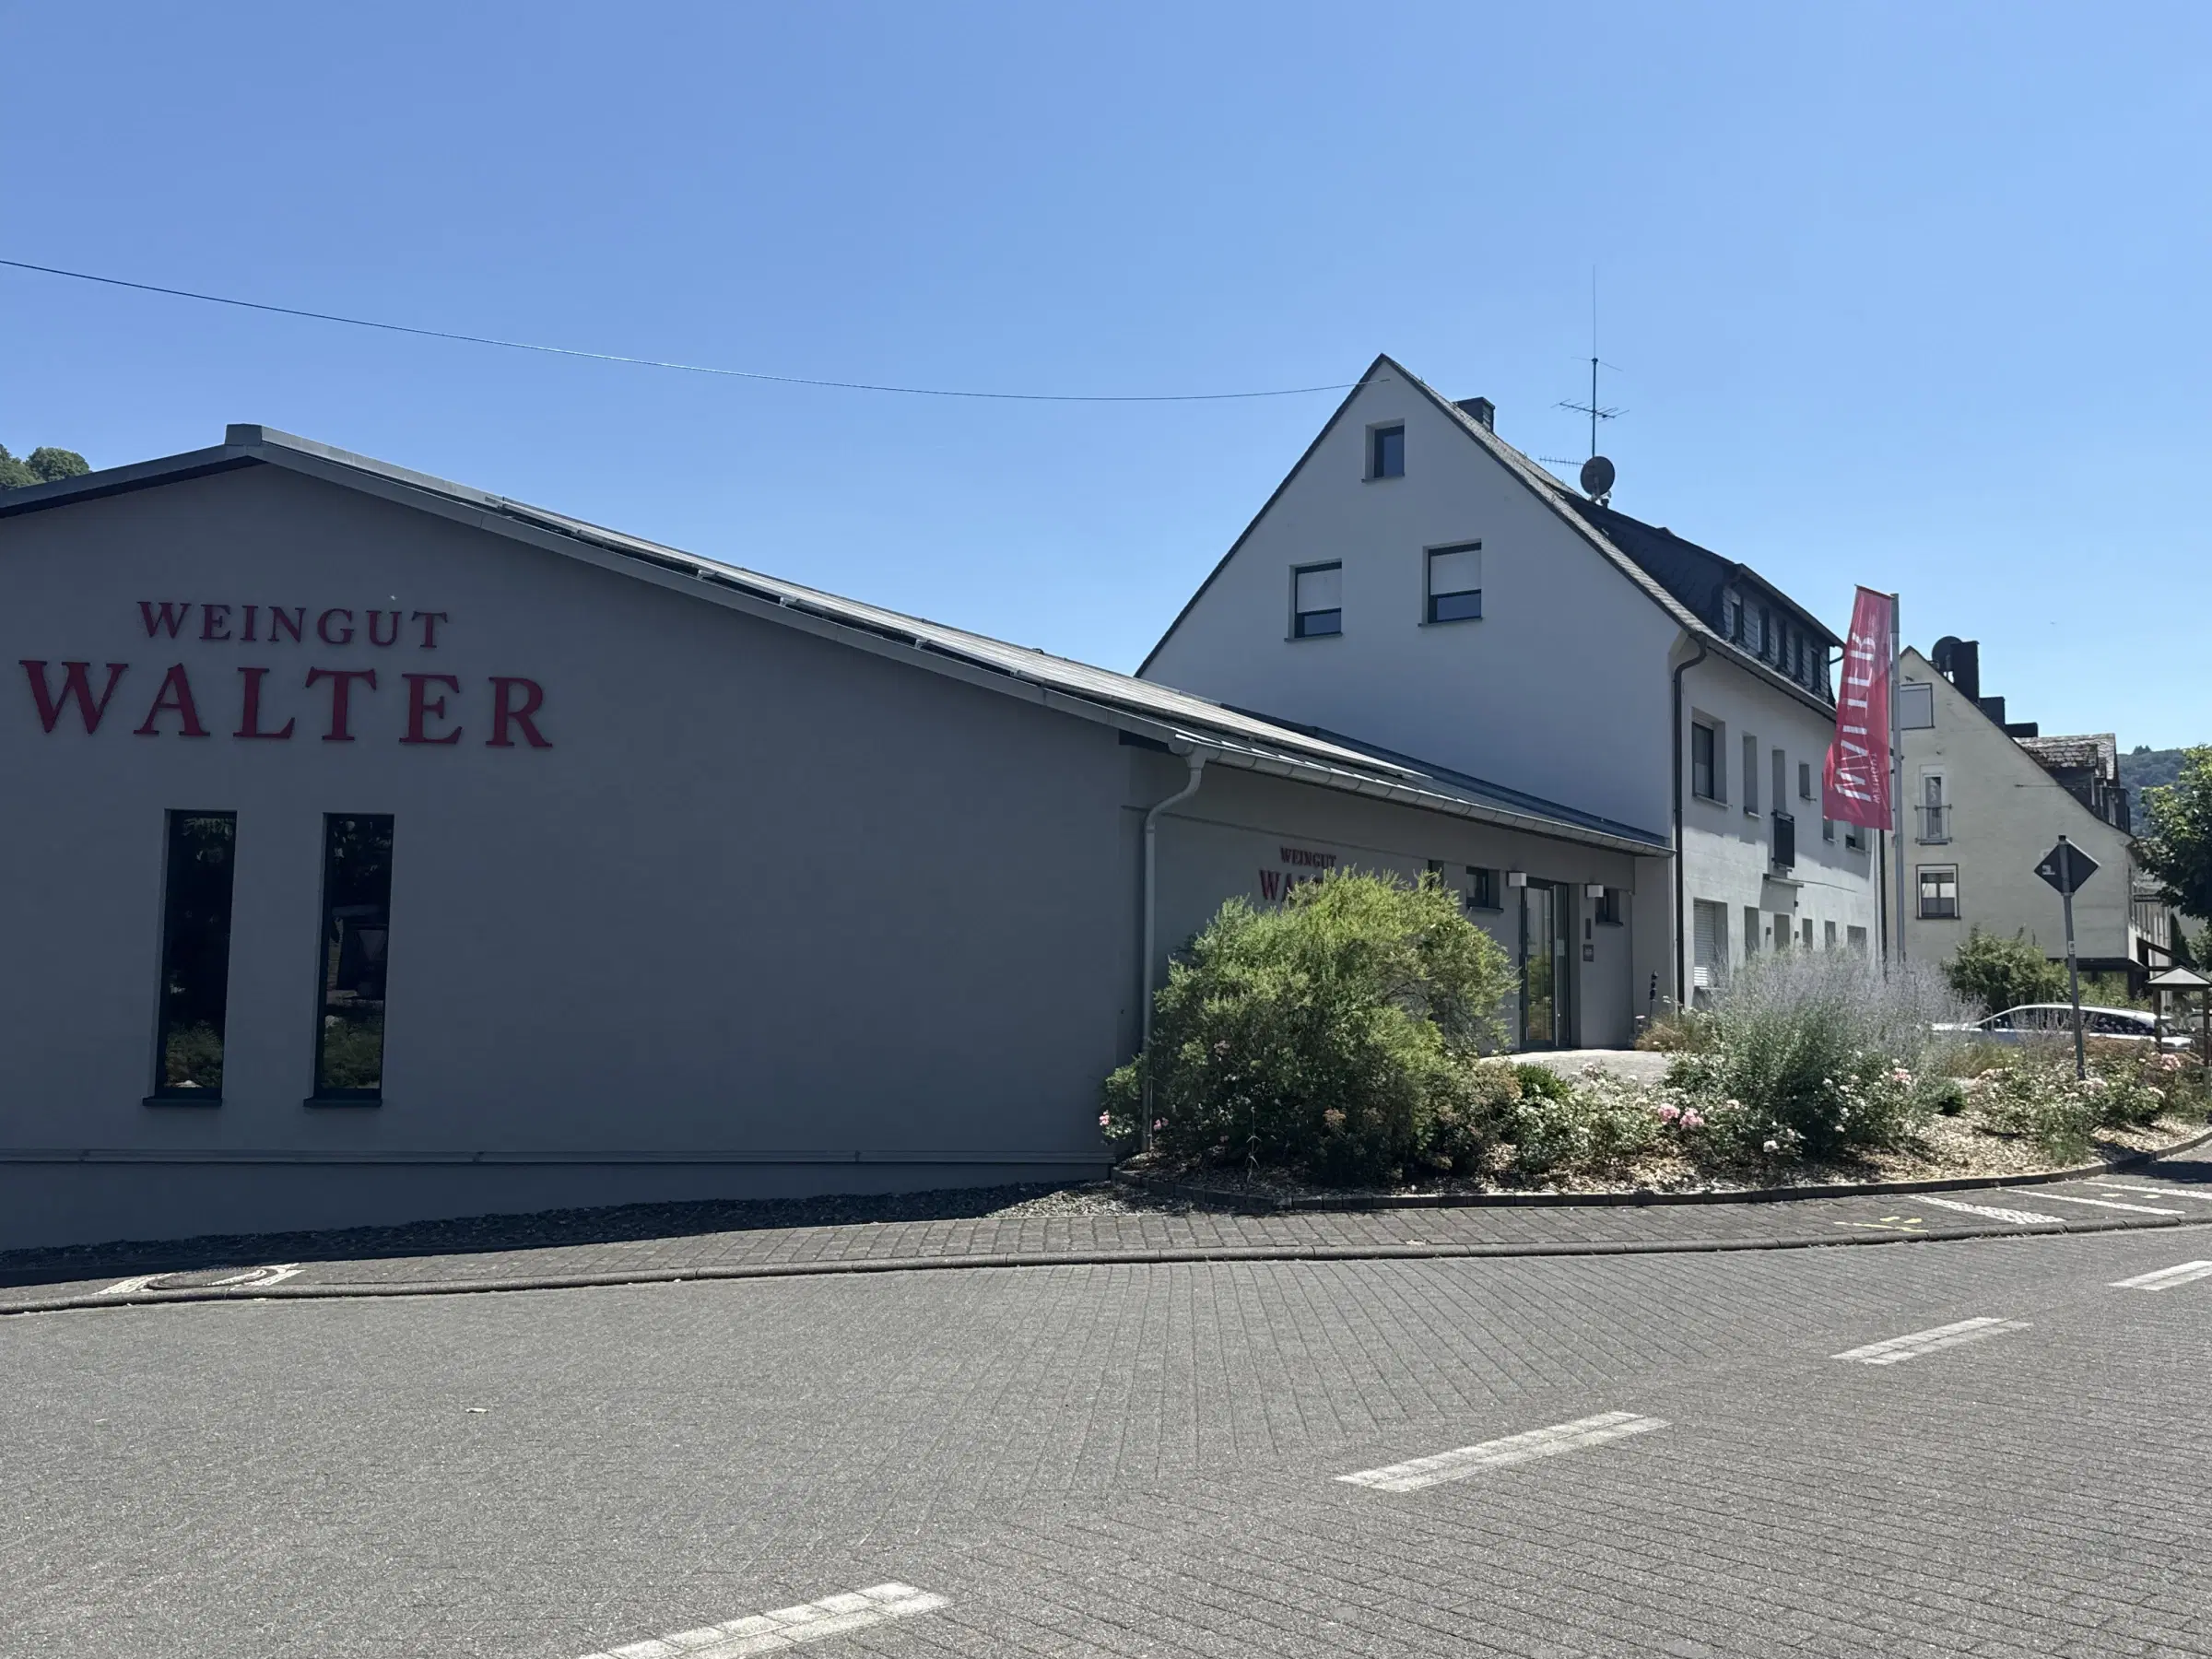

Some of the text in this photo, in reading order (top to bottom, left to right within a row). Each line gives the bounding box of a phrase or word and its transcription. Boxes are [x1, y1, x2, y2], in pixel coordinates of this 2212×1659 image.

[137, 601, 448, 648] WEINGUT
[18, 660, 552, 747] WALTER
[1279, 846, 1336, 868] WEINGUT
